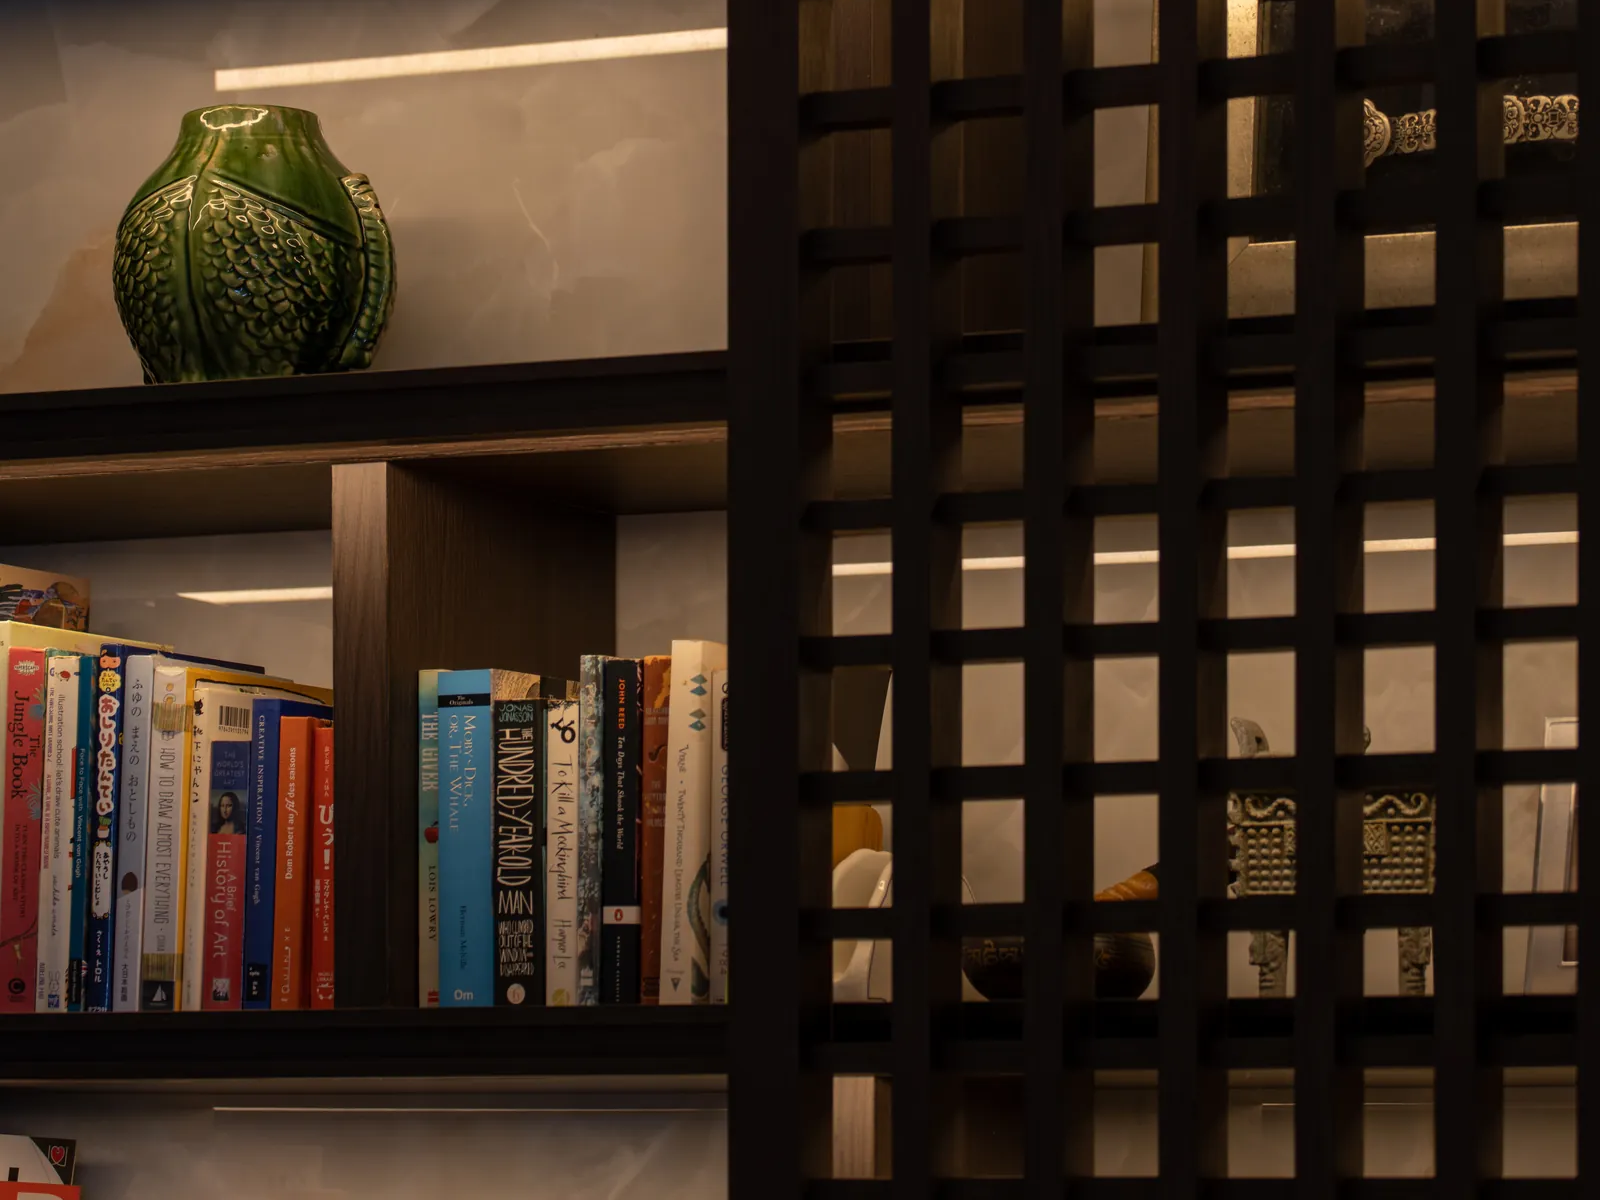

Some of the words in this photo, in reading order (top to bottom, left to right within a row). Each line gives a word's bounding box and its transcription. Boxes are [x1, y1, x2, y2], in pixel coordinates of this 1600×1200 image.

[131, 678, 143, 717] ふゆの
[617, 678, 627, 705] JOHN
[8, 691, 30, 747] Jungle
[56, 694, 66, 738] illustration
[498, 703, 534, 712] JONAS
[498, 712, 534, 723] JONASSON
[617, 707, 626, 730] REED
[257, 714, 266, 761] CREATIVE
[421, 711, 439, 741] THE
[520, 726, 534, 741] THE
[29, 734, 41, 758] The
[56, 739, 65, 768] school:
[99, 696, 117, 813] おしりたんてい
[128, 725, 141, 766] まえの
[224, 751, 236, 759] THE
[617, 735, 626, 750] Ten
[159, 747, 176, 771] HOW
[216, 760, 244, 769] WORLD'S
[288, 747, 298, 780] saisons
[421, 747, 439, 792] GIVER
[449, 740, 463, 773] THE
[552, 754, 574, 778] To
[615, 750, 625, 769] Days
[677, 744, 689, 774] VERNE
[11, 752, 28, 800] Book
[55, 769, 64, 787] let's
[78, 767, 85, 775] to
[158, 774, 176, 788] TO
[223, 778, 236, 786] ART
[616, 770, 626, 788] That
[54, 786, 63, 809] draw
[255, 764, 265, 824] INSPIRATION
[286, 782, 297, 797] des
[552, 781, 574, 803] Kill
[616, 789, 624, 812] Shook
[721, 764, 729, 825] GEORGE
[53, 808, 62, 827] cute
[126, 774, 139, 843] おとしもの
[158, 791, 176, 820] DRAW
[284, 797, 299, 816] fil
[449, 776, 463, 833] WHALE
[556, 805, 568, 816] a
[676, 789, 686, 823] TWENTY
[76, 815, 84, 843] Vincent
[286, 813, 296, 824] au
[616, 813, 625, 825] the
[52, 827, 62, 859] animals
[157, 822, 175, 859] ALMOST
[254, 834, 263, 864] Vincent
[284, 825, 296, 857] Robert
[615, 827, 624, 851] World
[675, 824, 685, 868] THOUSAND
[74, 858, 82, 879] Gogh
[210, 841, 232, 903] History
[284, 858, 294, 880] Dom
[549, 817, 574, 901] Mockingbird
[720, 830, 729, 887] ORWELL
[227, 873, 237, 882] A
[428, 865, 437, 893] LOIS
[673, 869, 684, 901] LEAGUES
[153, 862, 171, 925] EVERYTHING
[226, 886, 237, 912] Brief
[252, 884, 261, 905] Gogh
[497, 890, 533, 915] MAN
[214, 909, 230, 926] of
[428, 897, 437, 942] LOWRY
[459, 905, 467, 938] Herman
[673, 902, 683, 931] UNDER
[212, 931, 228, 958] Art
[551, 918, 573, 954] Harper
[673, 932, 681, 946] THE
[458, 939, 468, 970] Melville
[552, 955, 573, 970] Lee
[671, 946, 681, 961] SEA
[718, 942, 727, 976] 1984
[94, 958, 102, 983] トロル
